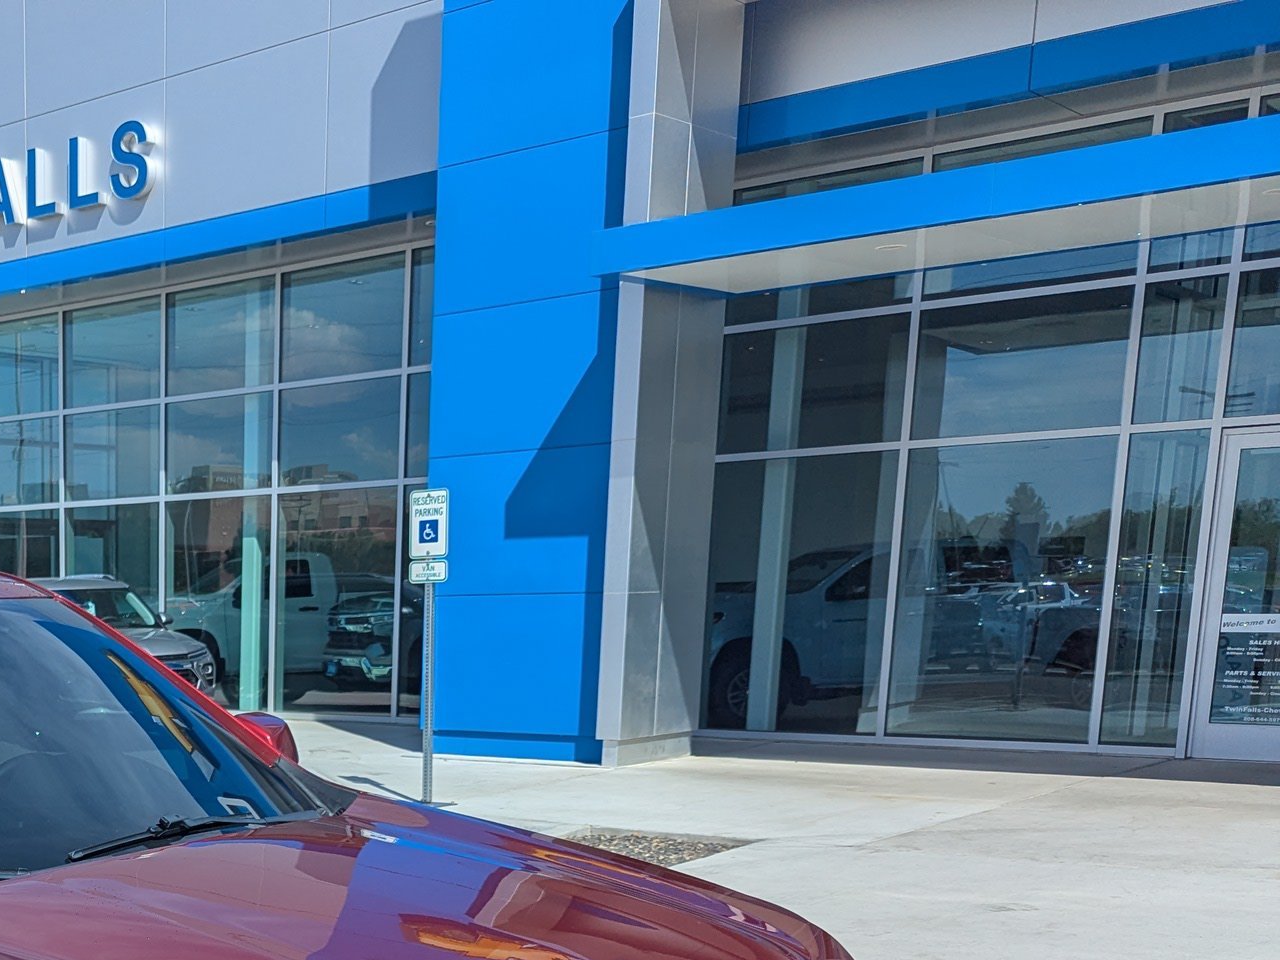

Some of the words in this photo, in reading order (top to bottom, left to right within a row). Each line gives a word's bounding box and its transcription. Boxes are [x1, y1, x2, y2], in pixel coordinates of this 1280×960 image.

[412, 494, 446, 506] RESERVED
[414, 507, 444, 517] PARKING
[1222, 620, 1264, 628] Welcome
